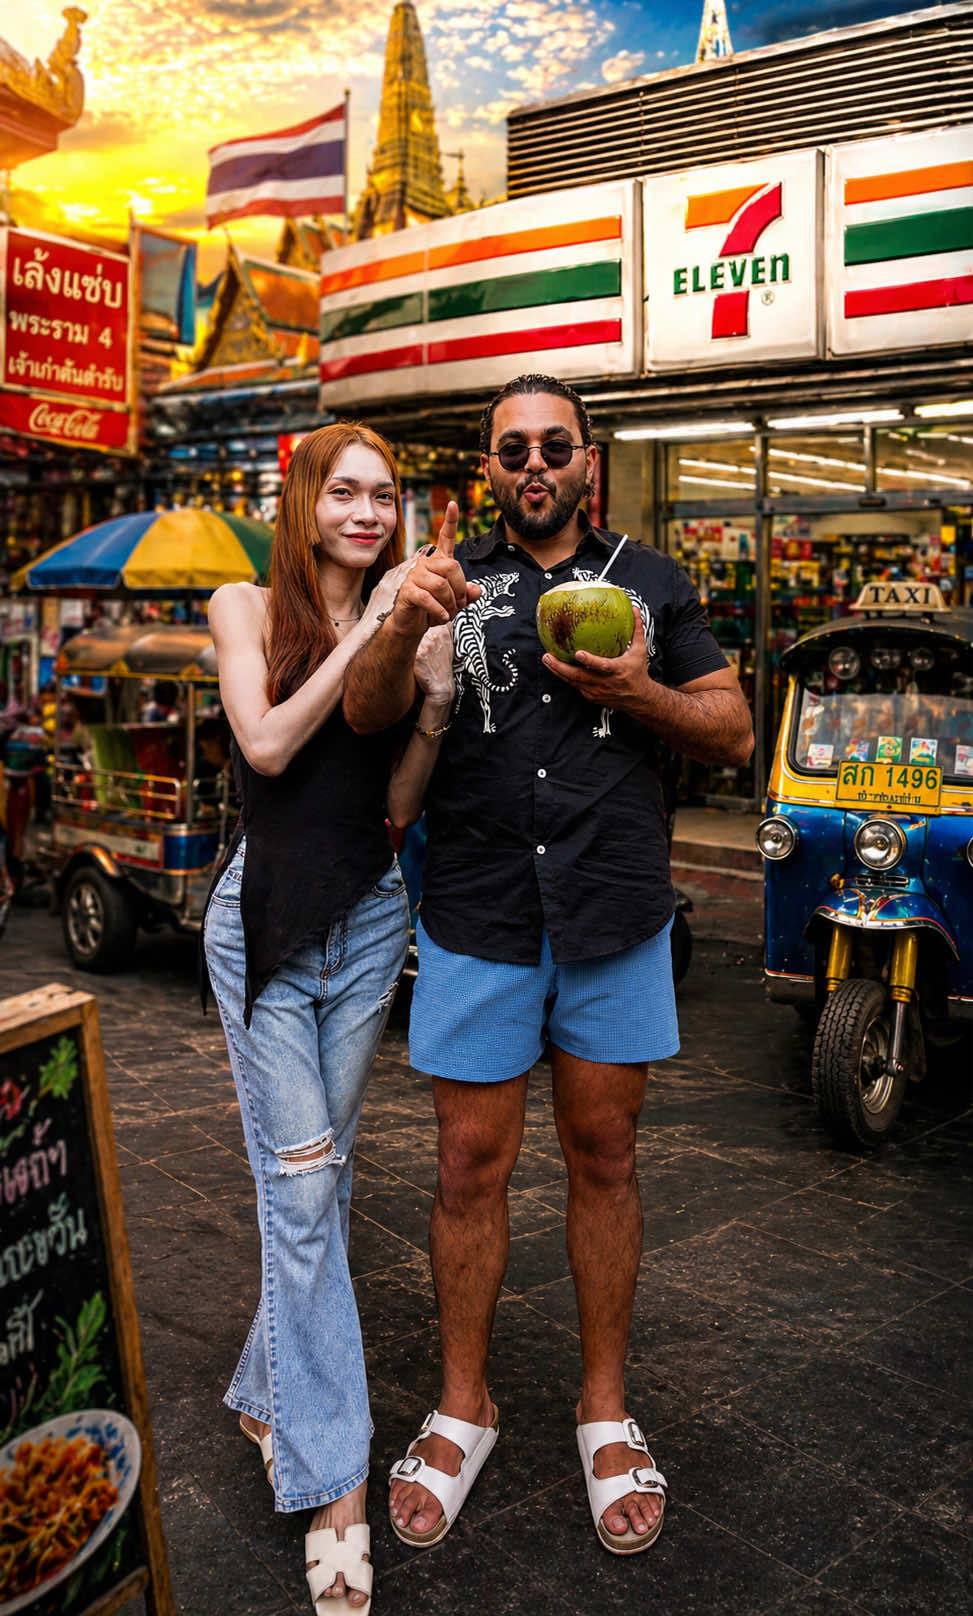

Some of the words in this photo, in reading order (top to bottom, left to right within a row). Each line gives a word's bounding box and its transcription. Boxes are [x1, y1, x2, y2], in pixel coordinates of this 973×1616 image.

[13, 247, 122, 309] เล้งแซ่บ
[685, 181, 782, 340] 7
[9, 310, 89, 345] พระราม
[98, 326, 113, 349] 4
[869, 586, 930, 604] TAXI
[843, 764, 874, 786] สก
[886, 767, 938, 789] 1496
